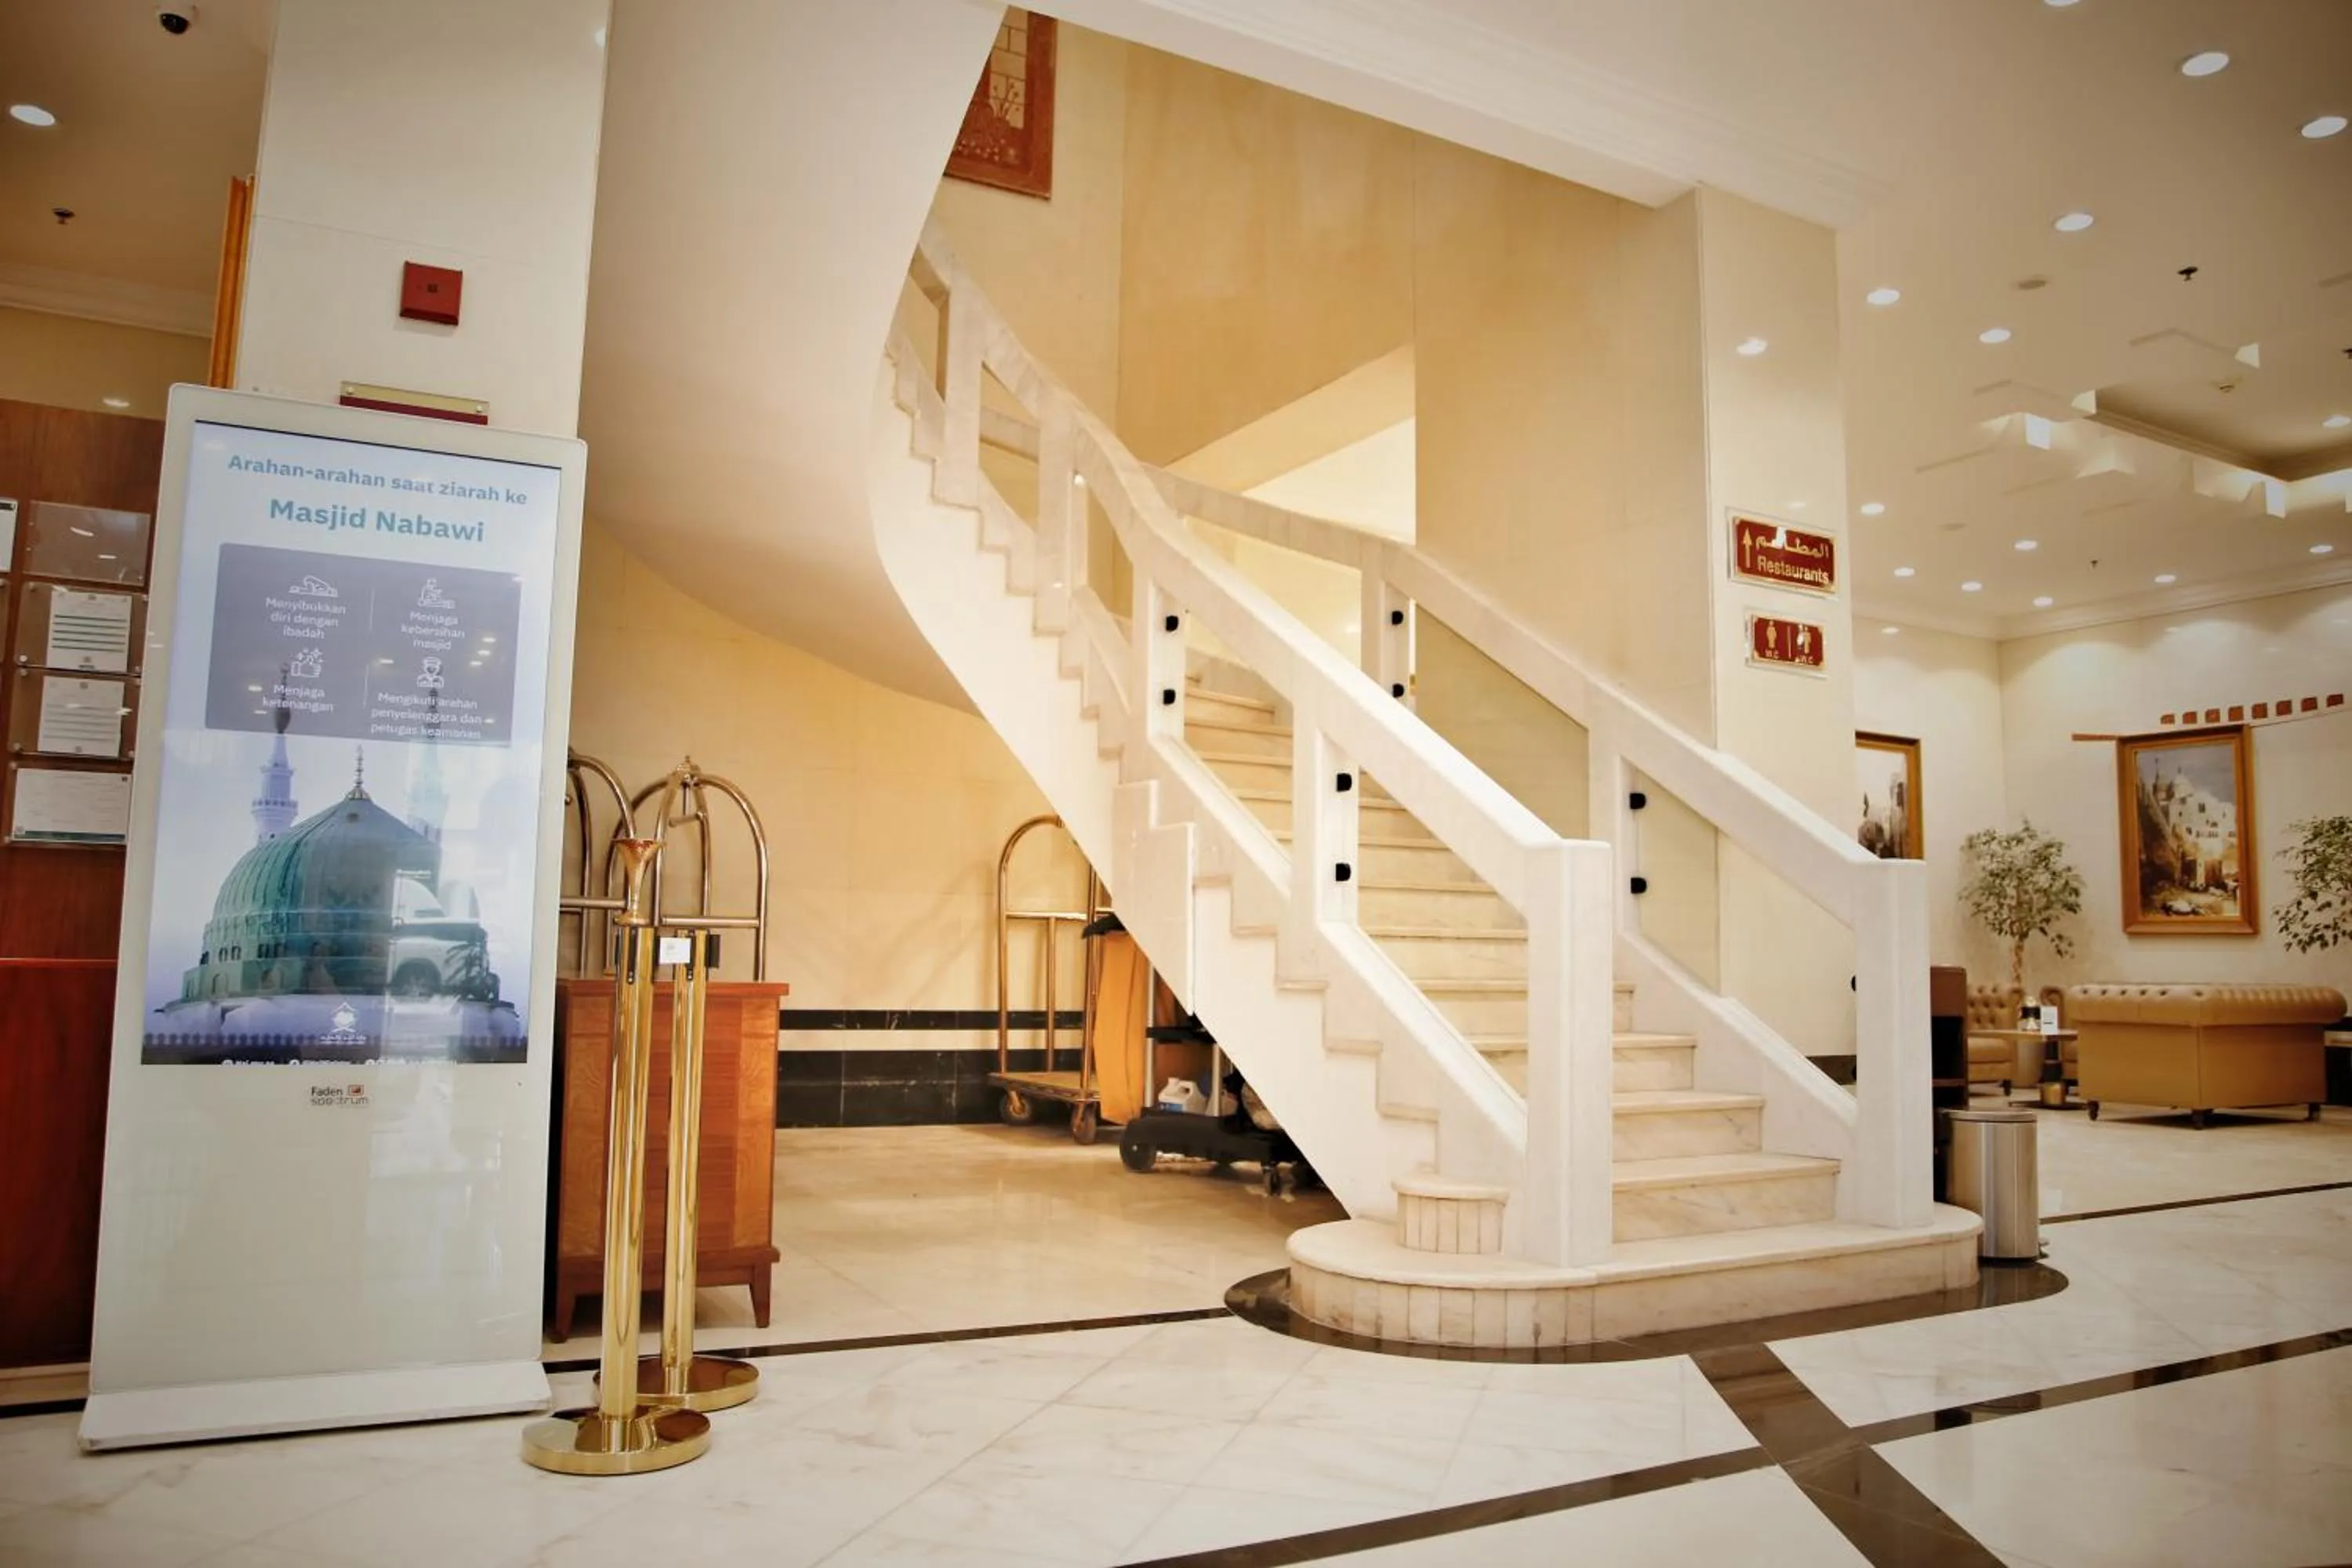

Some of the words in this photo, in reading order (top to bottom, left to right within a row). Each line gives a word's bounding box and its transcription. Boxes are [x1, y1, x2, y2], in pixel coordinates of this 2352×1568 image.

[228, 455, 385, 488] Arahan-arahan
[391, 476, 434, 493] saat
[438, 481, 499, 501] ziarah
[505, 488, 527, 504] ke
[270, 499, 366, 530] Masjid
[376, 511, 484, 542] Nabawi
[1758, 555, 1829, 583] Restaurants
[270, 612, 290, 622] diri
[294, 612, 338, 627] dengan
[410, 612, 458, 626] Menjaga
[283, 625, 325, 638] ibadah
[460, 714, 482, 724] dan
